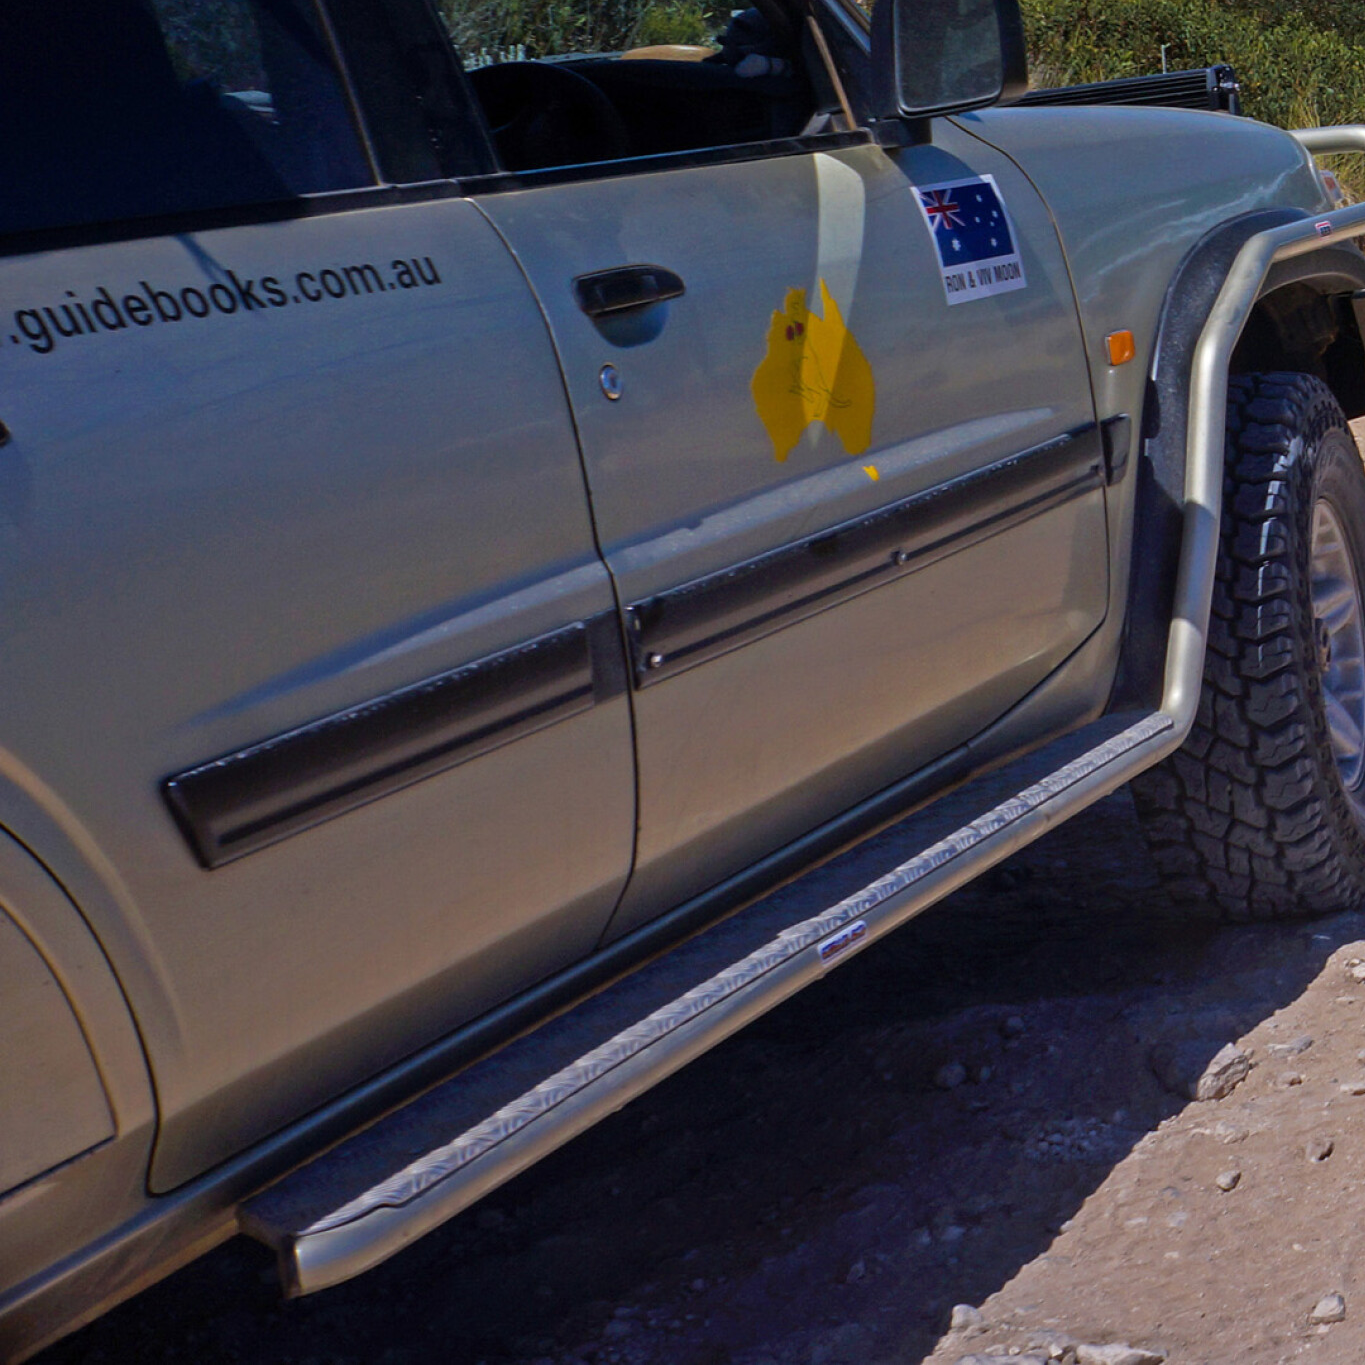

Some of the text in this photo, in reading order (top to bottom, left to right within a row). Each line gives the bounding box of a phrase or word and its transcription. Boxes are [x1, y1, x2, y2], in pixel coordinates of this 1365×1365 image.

[945, 262, 1021, 293] RON & VIV MOON
